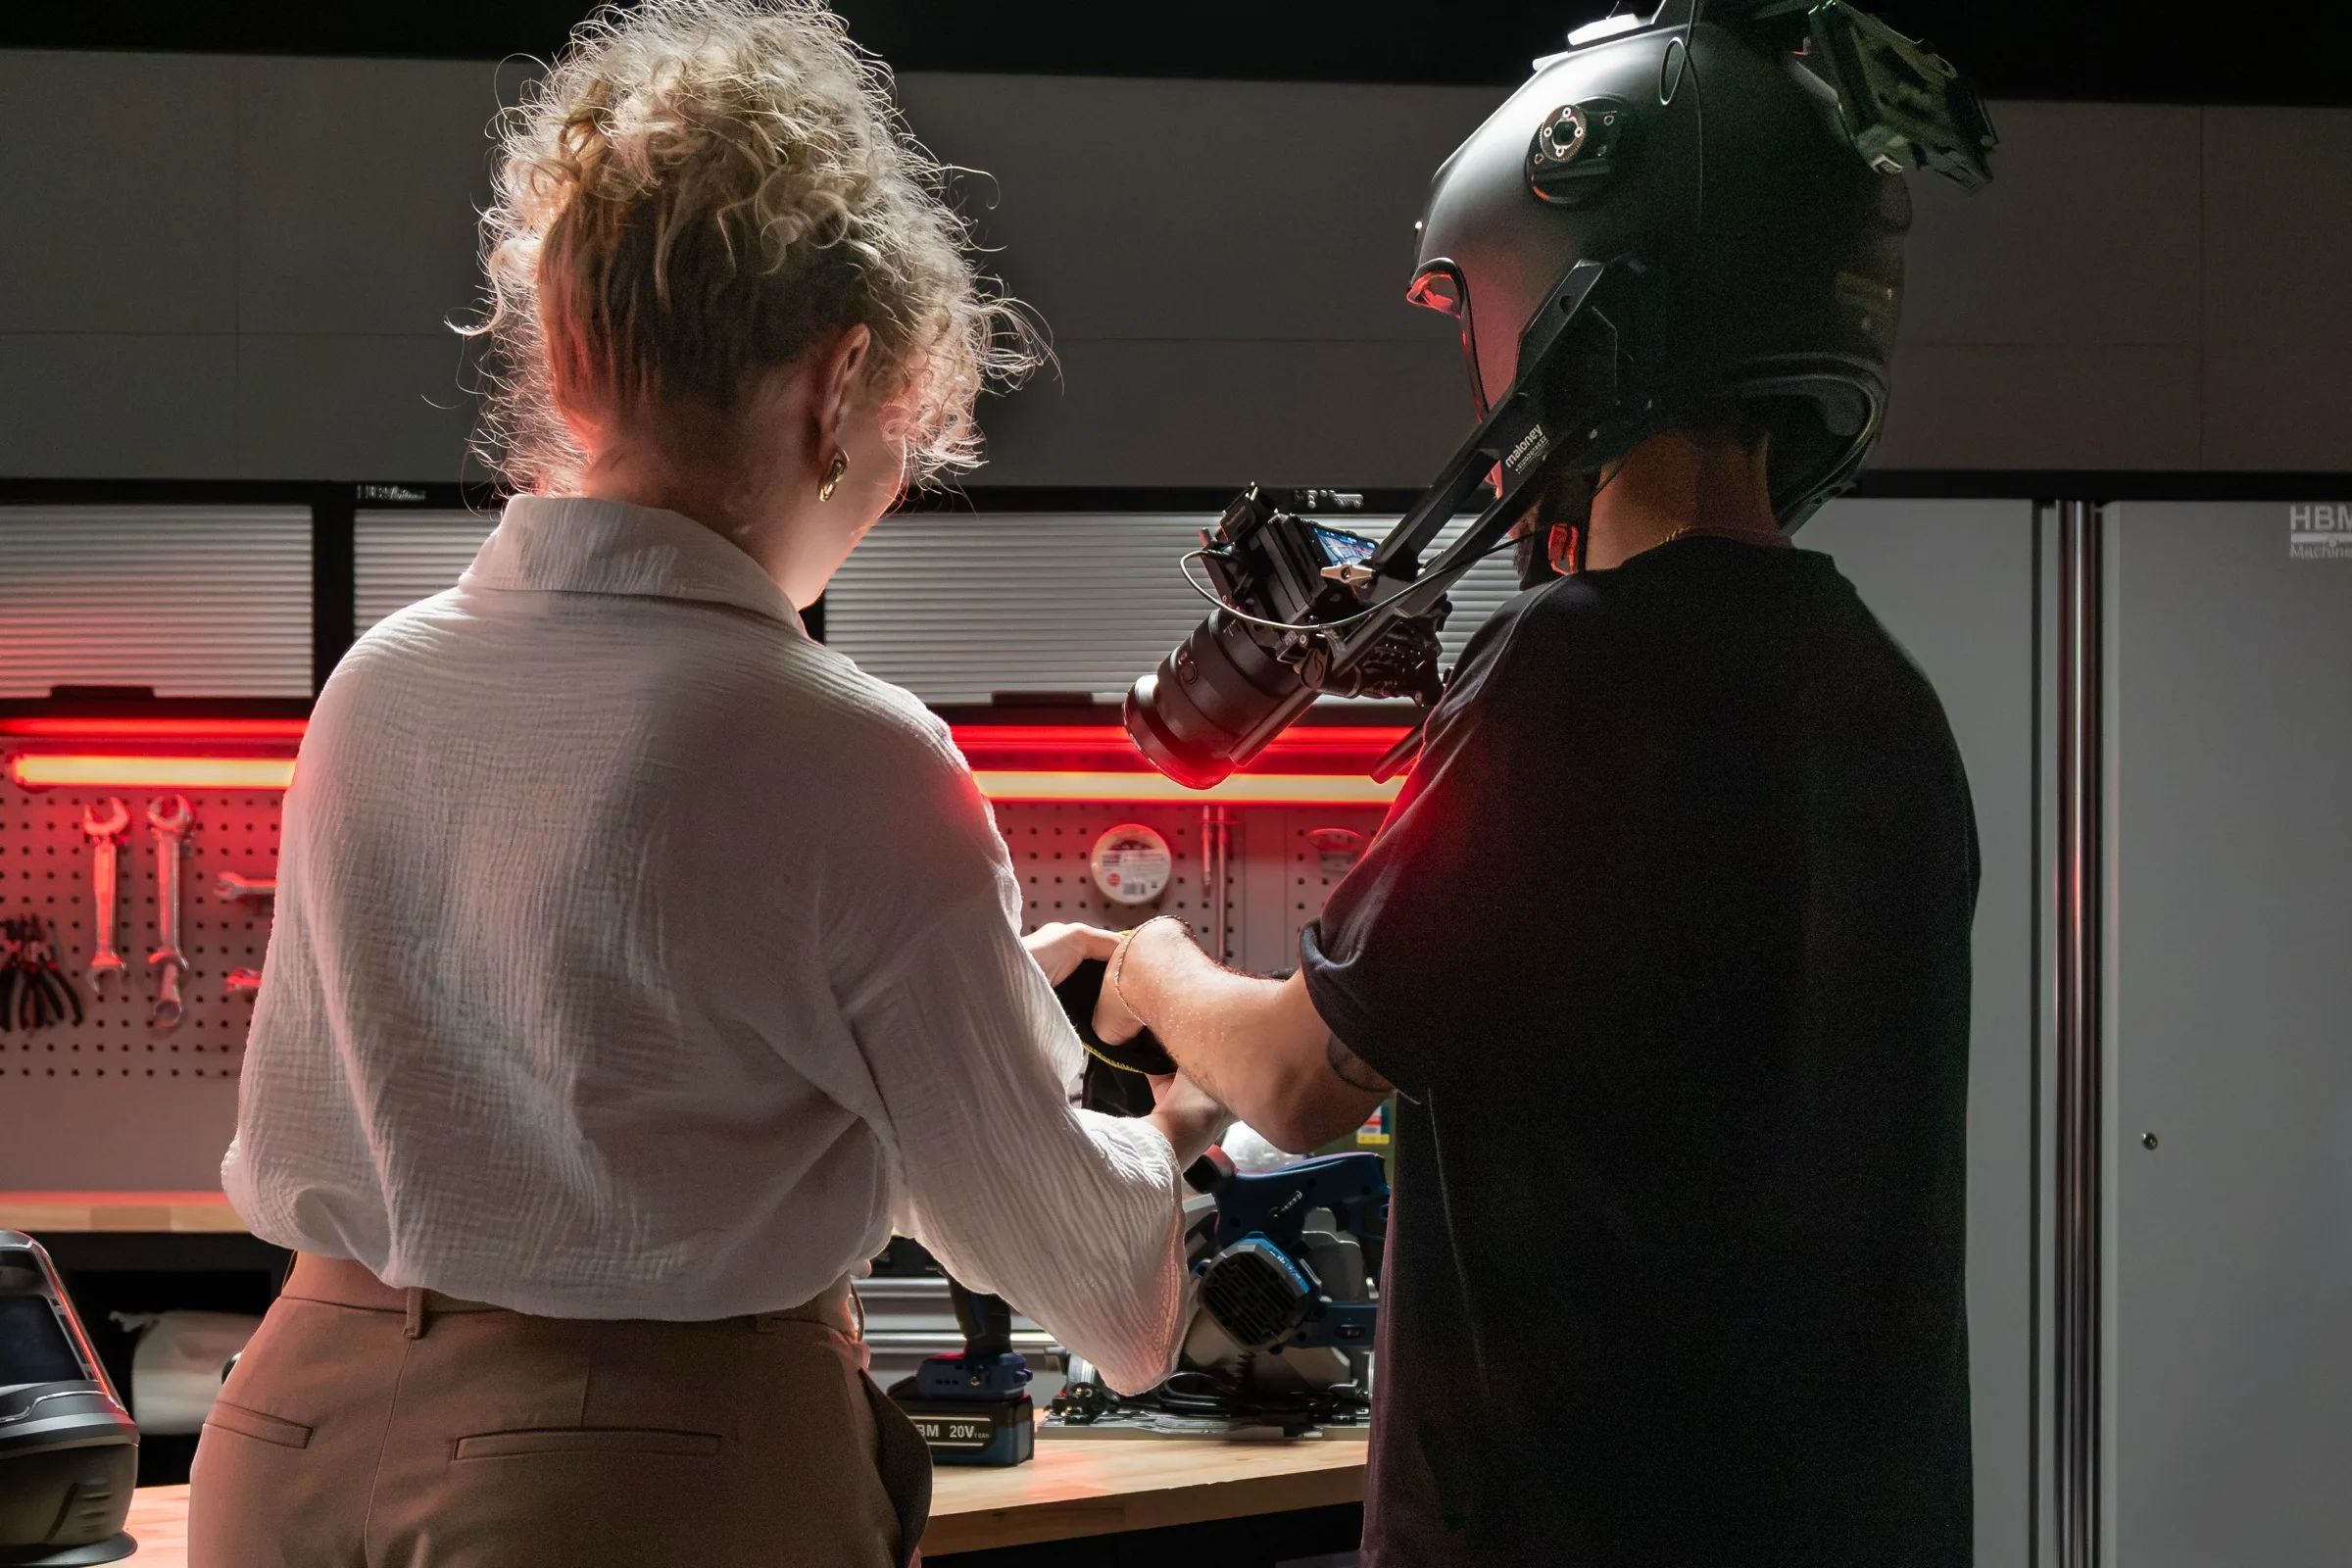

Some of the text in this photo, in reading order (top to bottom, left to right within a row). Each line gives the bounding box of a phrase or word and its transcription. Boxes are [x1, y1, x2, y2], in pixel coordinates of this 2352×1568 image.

[1505, 424, 1544, 467] maloney
[2290, 505, 2352, 530] HBM
[949, 1425, 975, 1439] 20V
